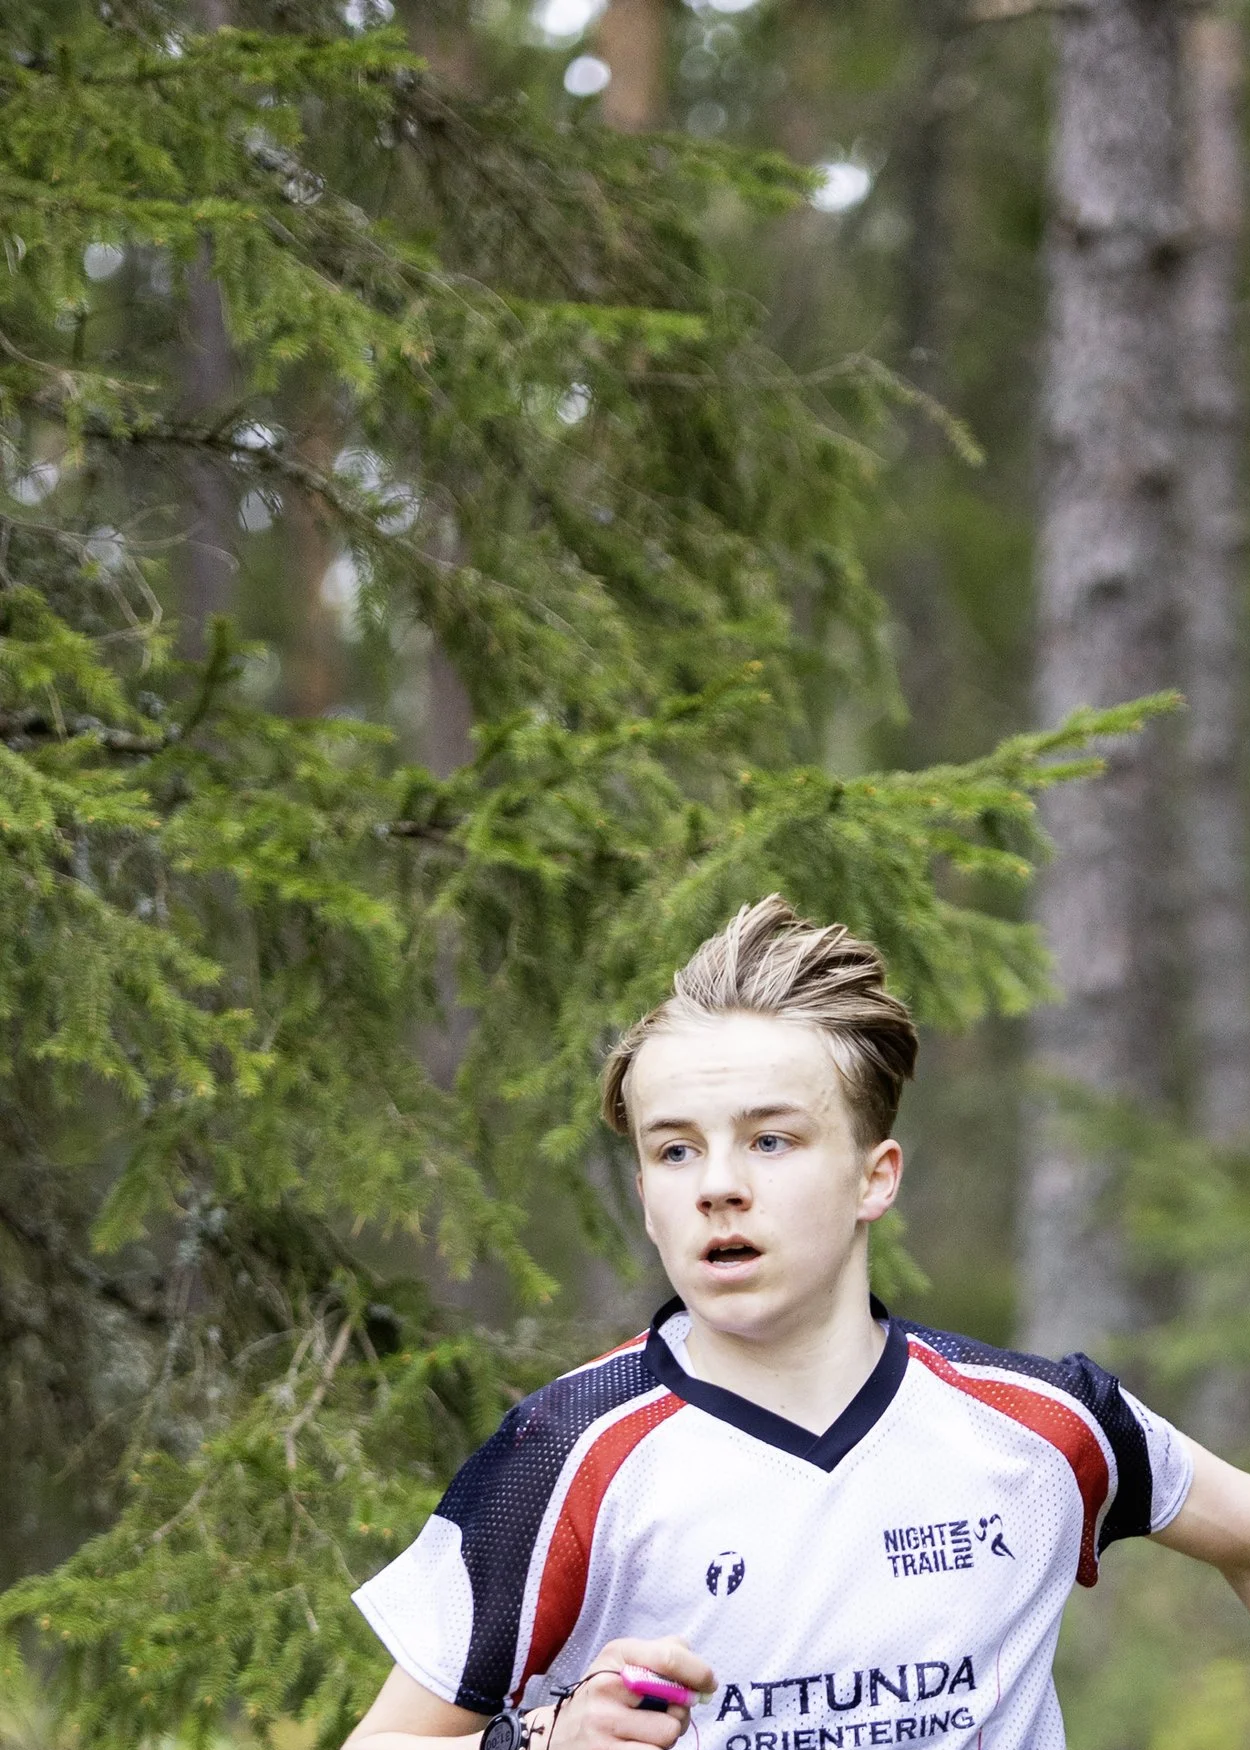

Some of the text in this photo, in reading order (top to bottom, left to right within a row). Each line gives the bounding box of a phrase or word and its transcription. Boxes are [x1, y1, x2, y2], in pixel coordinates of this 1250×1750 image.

[883, 1523, 946, 1553] NIGHT
[948, 1519, 975, 1570] RUN
[887, 1549, 954, 1578] TRAIL
[715, 1654, 978, 1722] ATTUNDA
